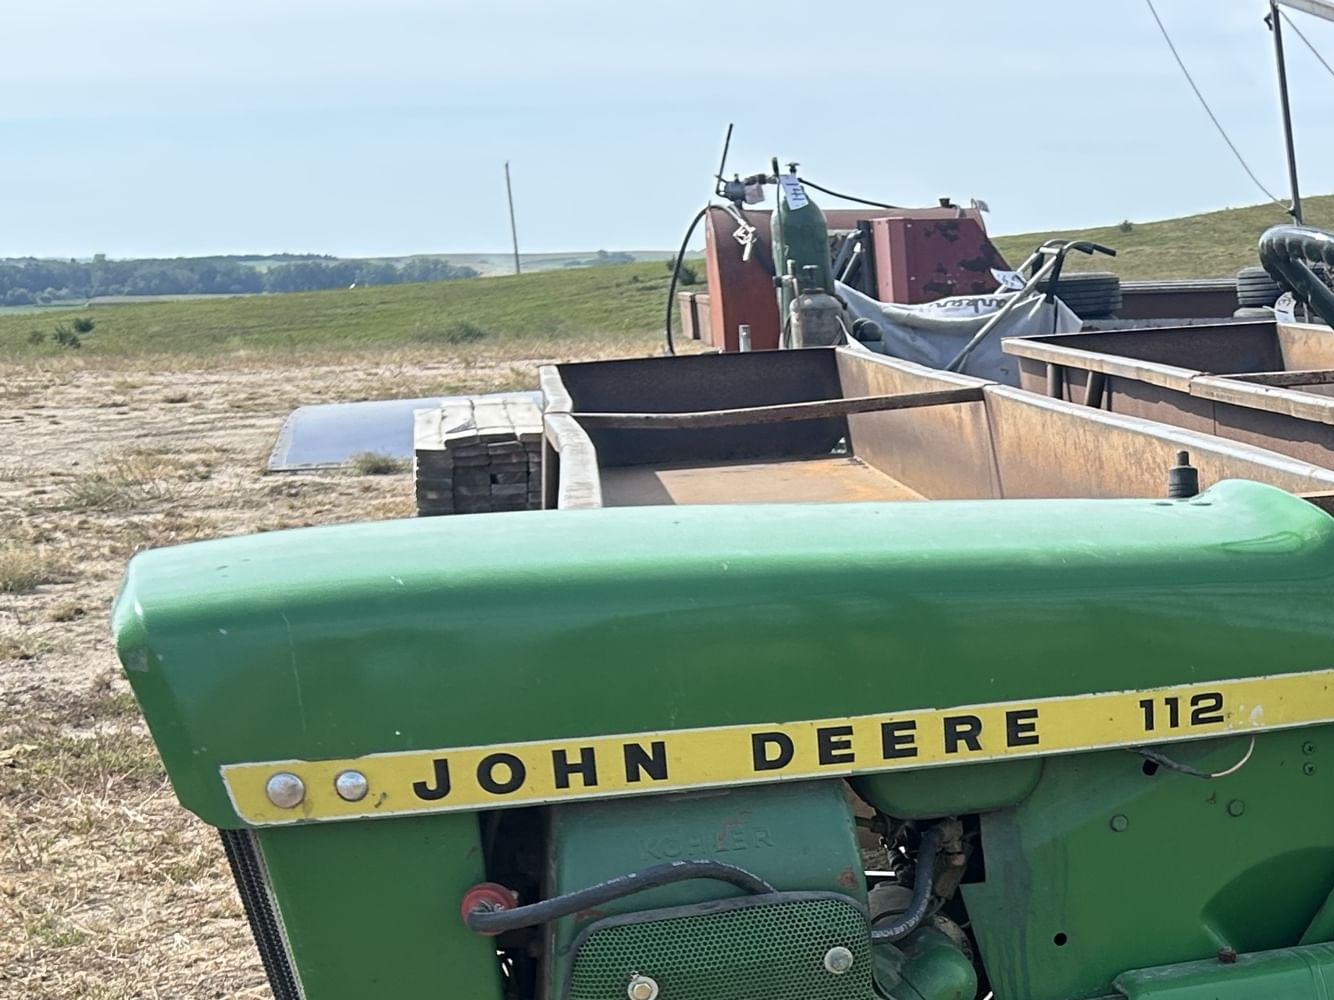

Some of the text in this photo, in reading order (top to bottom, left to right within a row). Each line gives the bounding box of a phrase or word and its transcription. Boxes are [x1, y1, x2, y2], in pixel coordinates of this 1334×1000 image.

[412, 692, 1225, 801] JOHN DEERE 112
[639, 825, 775, 860] KOHLER
